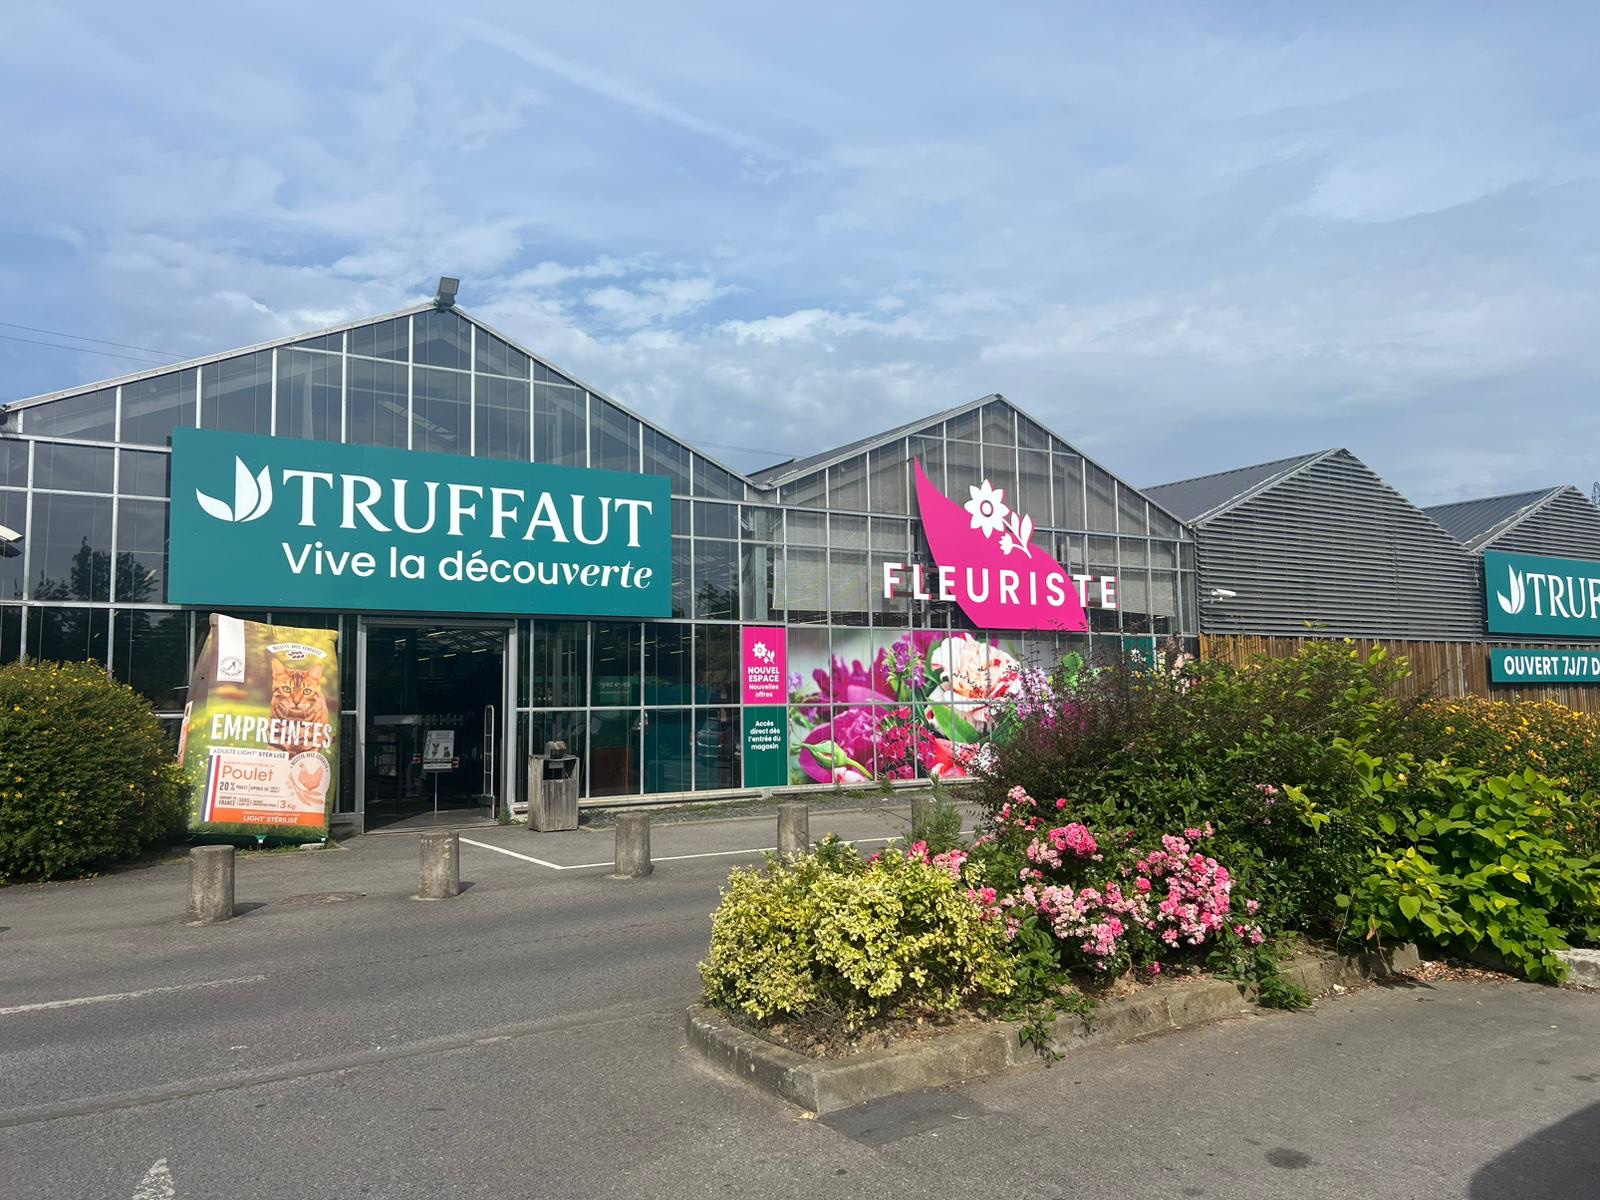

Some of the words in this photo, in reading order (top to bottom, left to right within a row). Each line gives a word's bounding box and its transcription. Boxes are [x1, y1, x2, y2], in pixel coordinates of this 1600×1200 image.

[282, 469, 653, 548] TRUFFAUT
[281, 541, 376, 577] Vive
[390, 546, 425, 580] la
[438, 549, 653, 590] découverte
[882, 562, 1118, 609] FLEURISTE
[747, 666, 780, 674] NOUVEL
[1504, 655, 1559, 676] OUVERT
[1562, 656, 1588, 676] 7J/7
[748, 674, 779, 682] ESPACE
[751, 743, 779, 751] magasin
[221, 764, 274, 782] Poulet
[279, 799, 286, 809] 3
